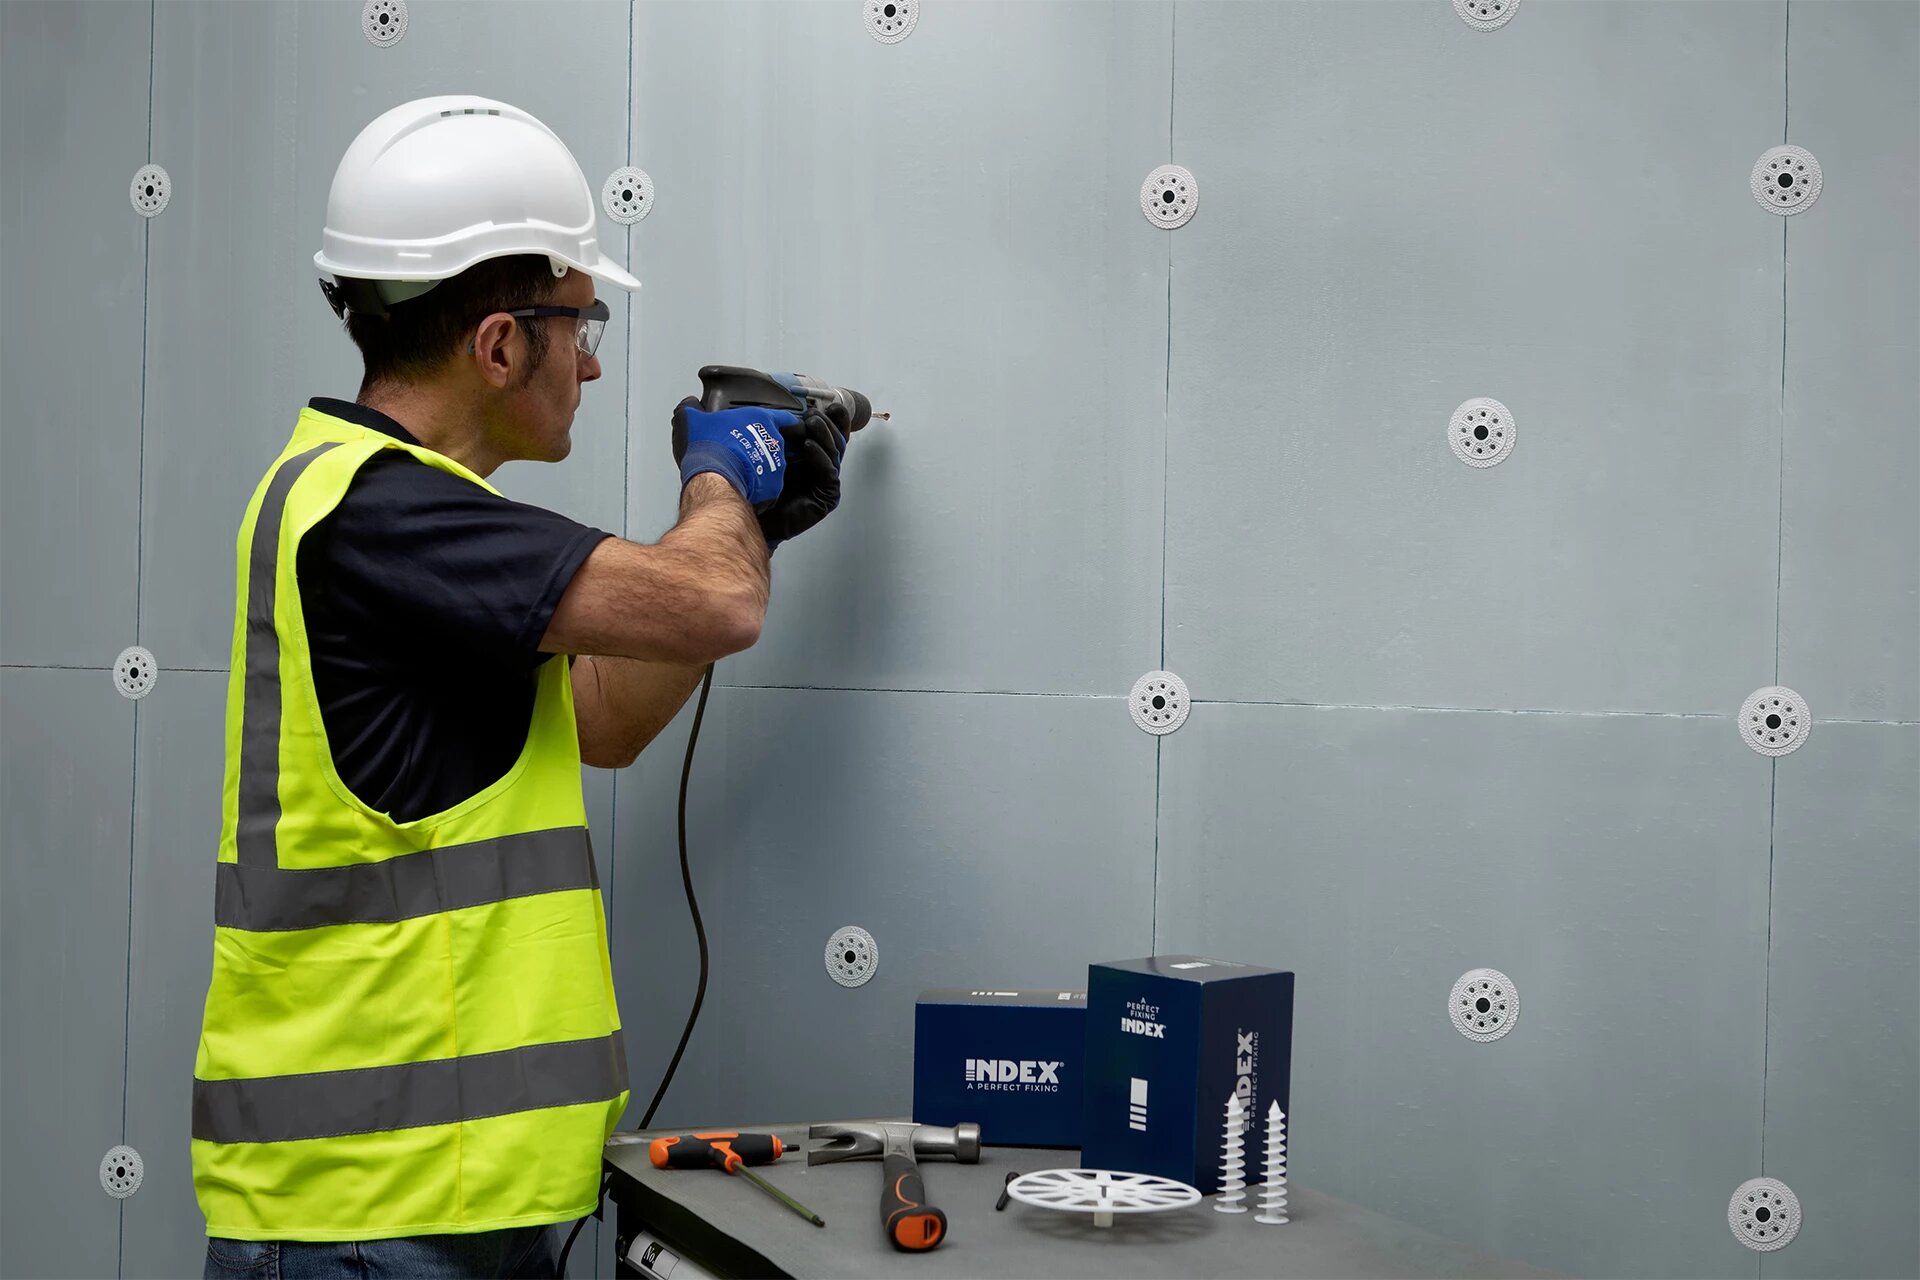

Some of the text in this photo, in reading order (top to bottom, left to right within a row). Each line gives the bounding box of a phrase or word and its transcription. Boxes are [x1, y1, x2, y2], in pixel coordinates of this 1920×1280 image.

[1126, 1001, 1160, 1014] PERFECT
[1140, 996, 1147, 1004] A
[1130, 1009, 1156, 1021] FIXING
[1121, 1017, 1165, 1039] INDEX
[1252, 1031, 1260, 1067] FIXING
[965, 1058, 1060, 1084] INDEX
[966, 1082, 1058, 1093] A PERFECT FIXING
[1250, 1071, 1258, 1118] PERFECT
[644, 1245, 656, 1264] No.
